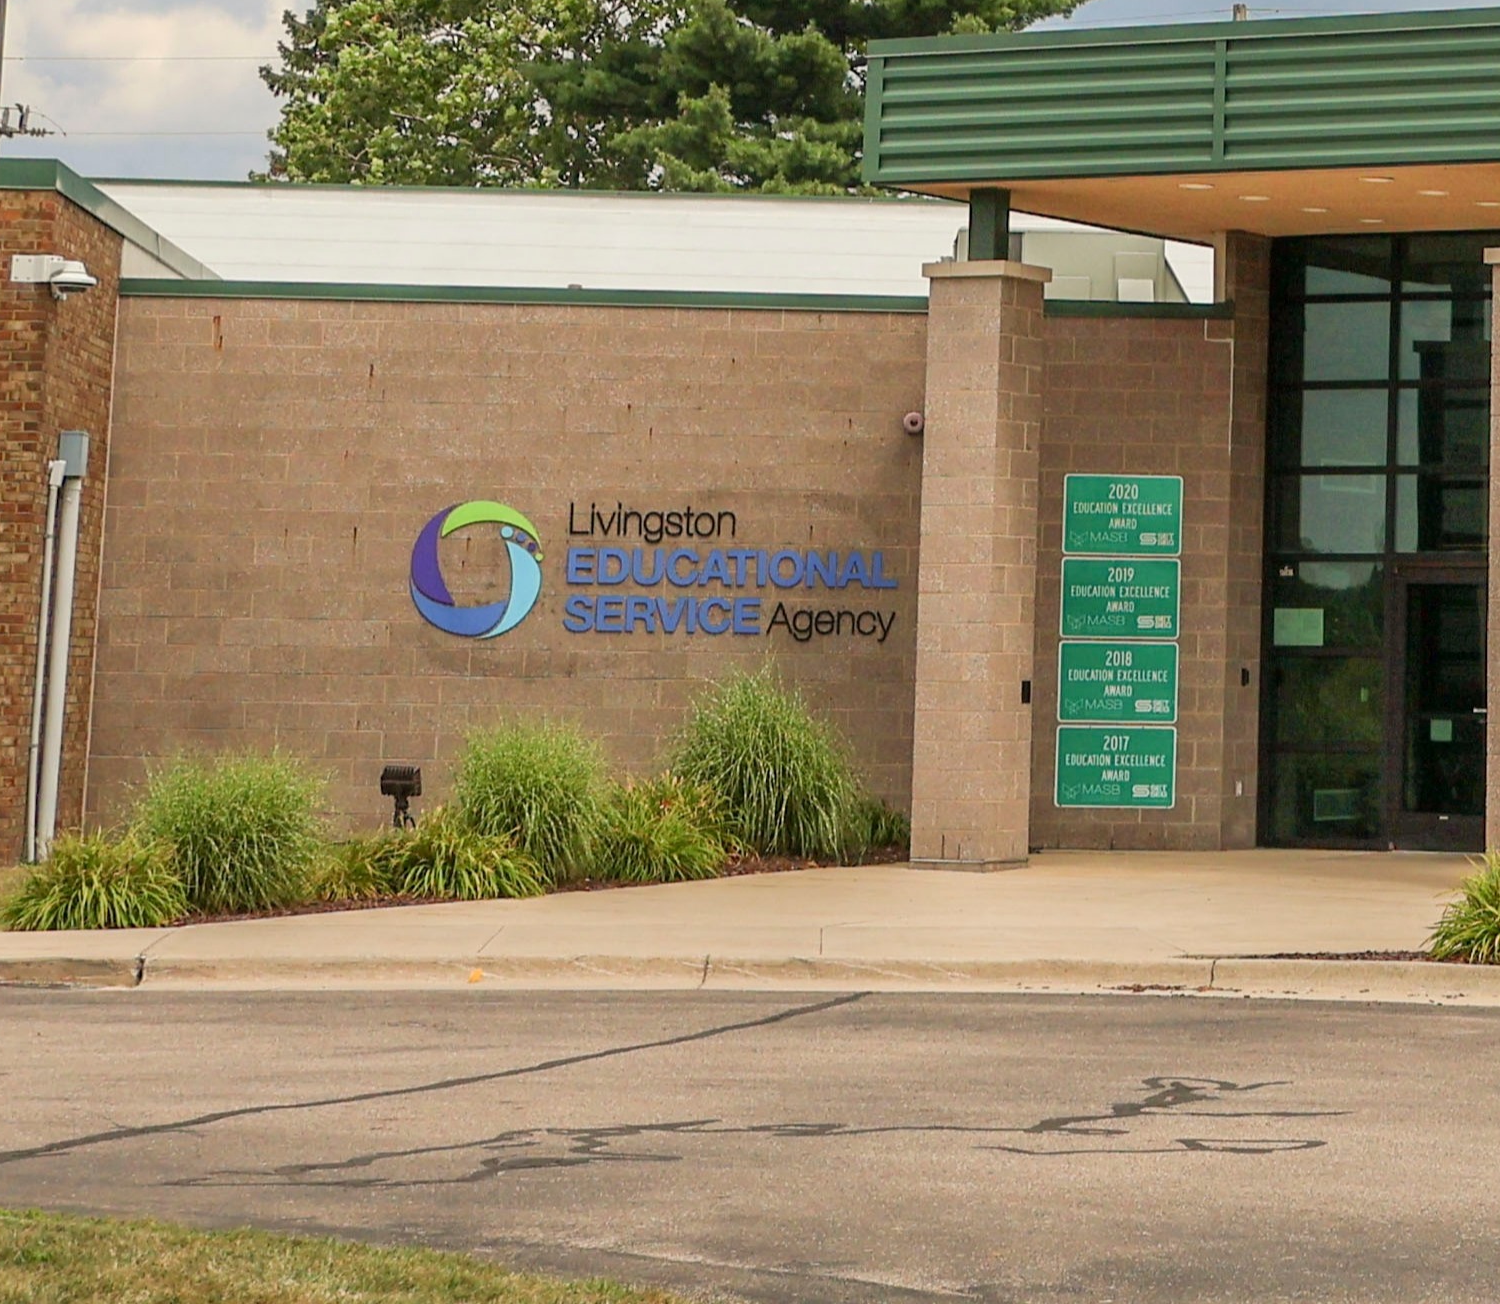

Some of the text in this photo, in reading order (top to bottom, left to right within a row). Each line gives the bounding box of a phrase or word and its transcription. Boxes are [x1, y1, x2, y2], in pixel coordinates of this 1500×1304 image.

[1108, 484, 1139, 500] 2020
[1073, 502, 1172, 515] EDUCATION EXCELLENCE
[568, 500, 737, 544] Livingston
[1108, 518, 1137, 530] AWARD
[564, 546, 898, 589] EDUCATIONAL
[1108, 568, 1134, 583] 2019
[1070, 585, 1170, 598] EDUCATION EXCELLENCE
[1106, 601, 1134, 613] AWARD
[562, 596, 896, 642] SERVICE Agency
[1105, 651, 1132, 666] 2018
[1068, 669, 1168, 682] EDUCATION EXCELLENCE
[1104, 685, 1132, 697] AWARD
[1085, 699, 1123, 710] MASB
[1103, 736, 1130, 751] 2017
[1065, 754, 1165, 767] EDUCATION EXCELLENCE
[1101, 770, 1130, 782] AWARD
[1082, 785, 1120, 795] MASB
